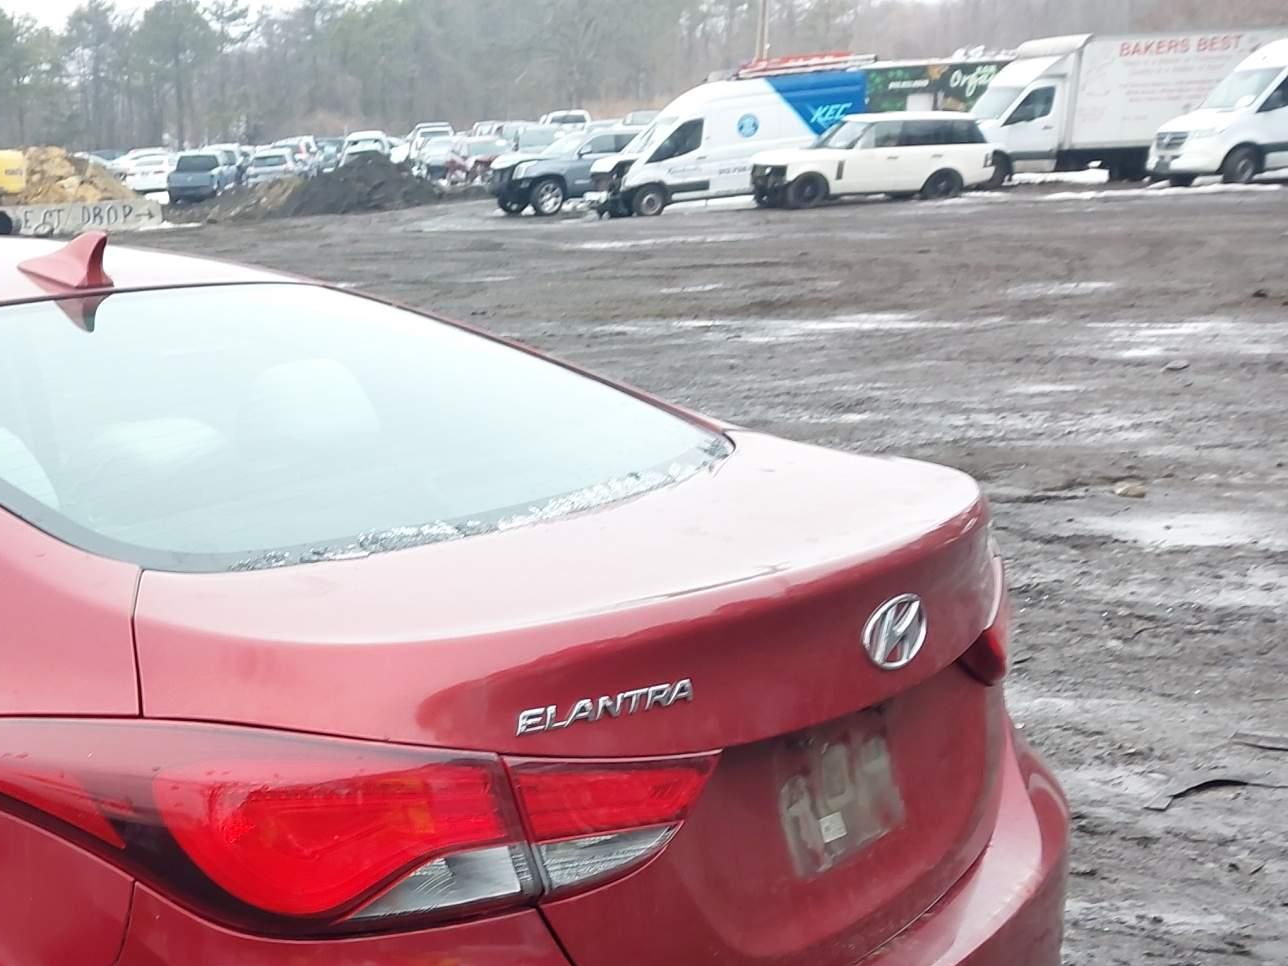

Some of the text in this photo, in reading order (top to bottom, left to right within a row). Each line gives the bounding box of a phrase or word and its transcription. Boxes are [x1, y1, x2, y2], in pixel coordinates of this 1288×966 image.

[1119, 34, 1242, 57] BAKERS BEST
[81, 204, 133, 225] DROP
[516, 679, 693, 736] ELANTRA
